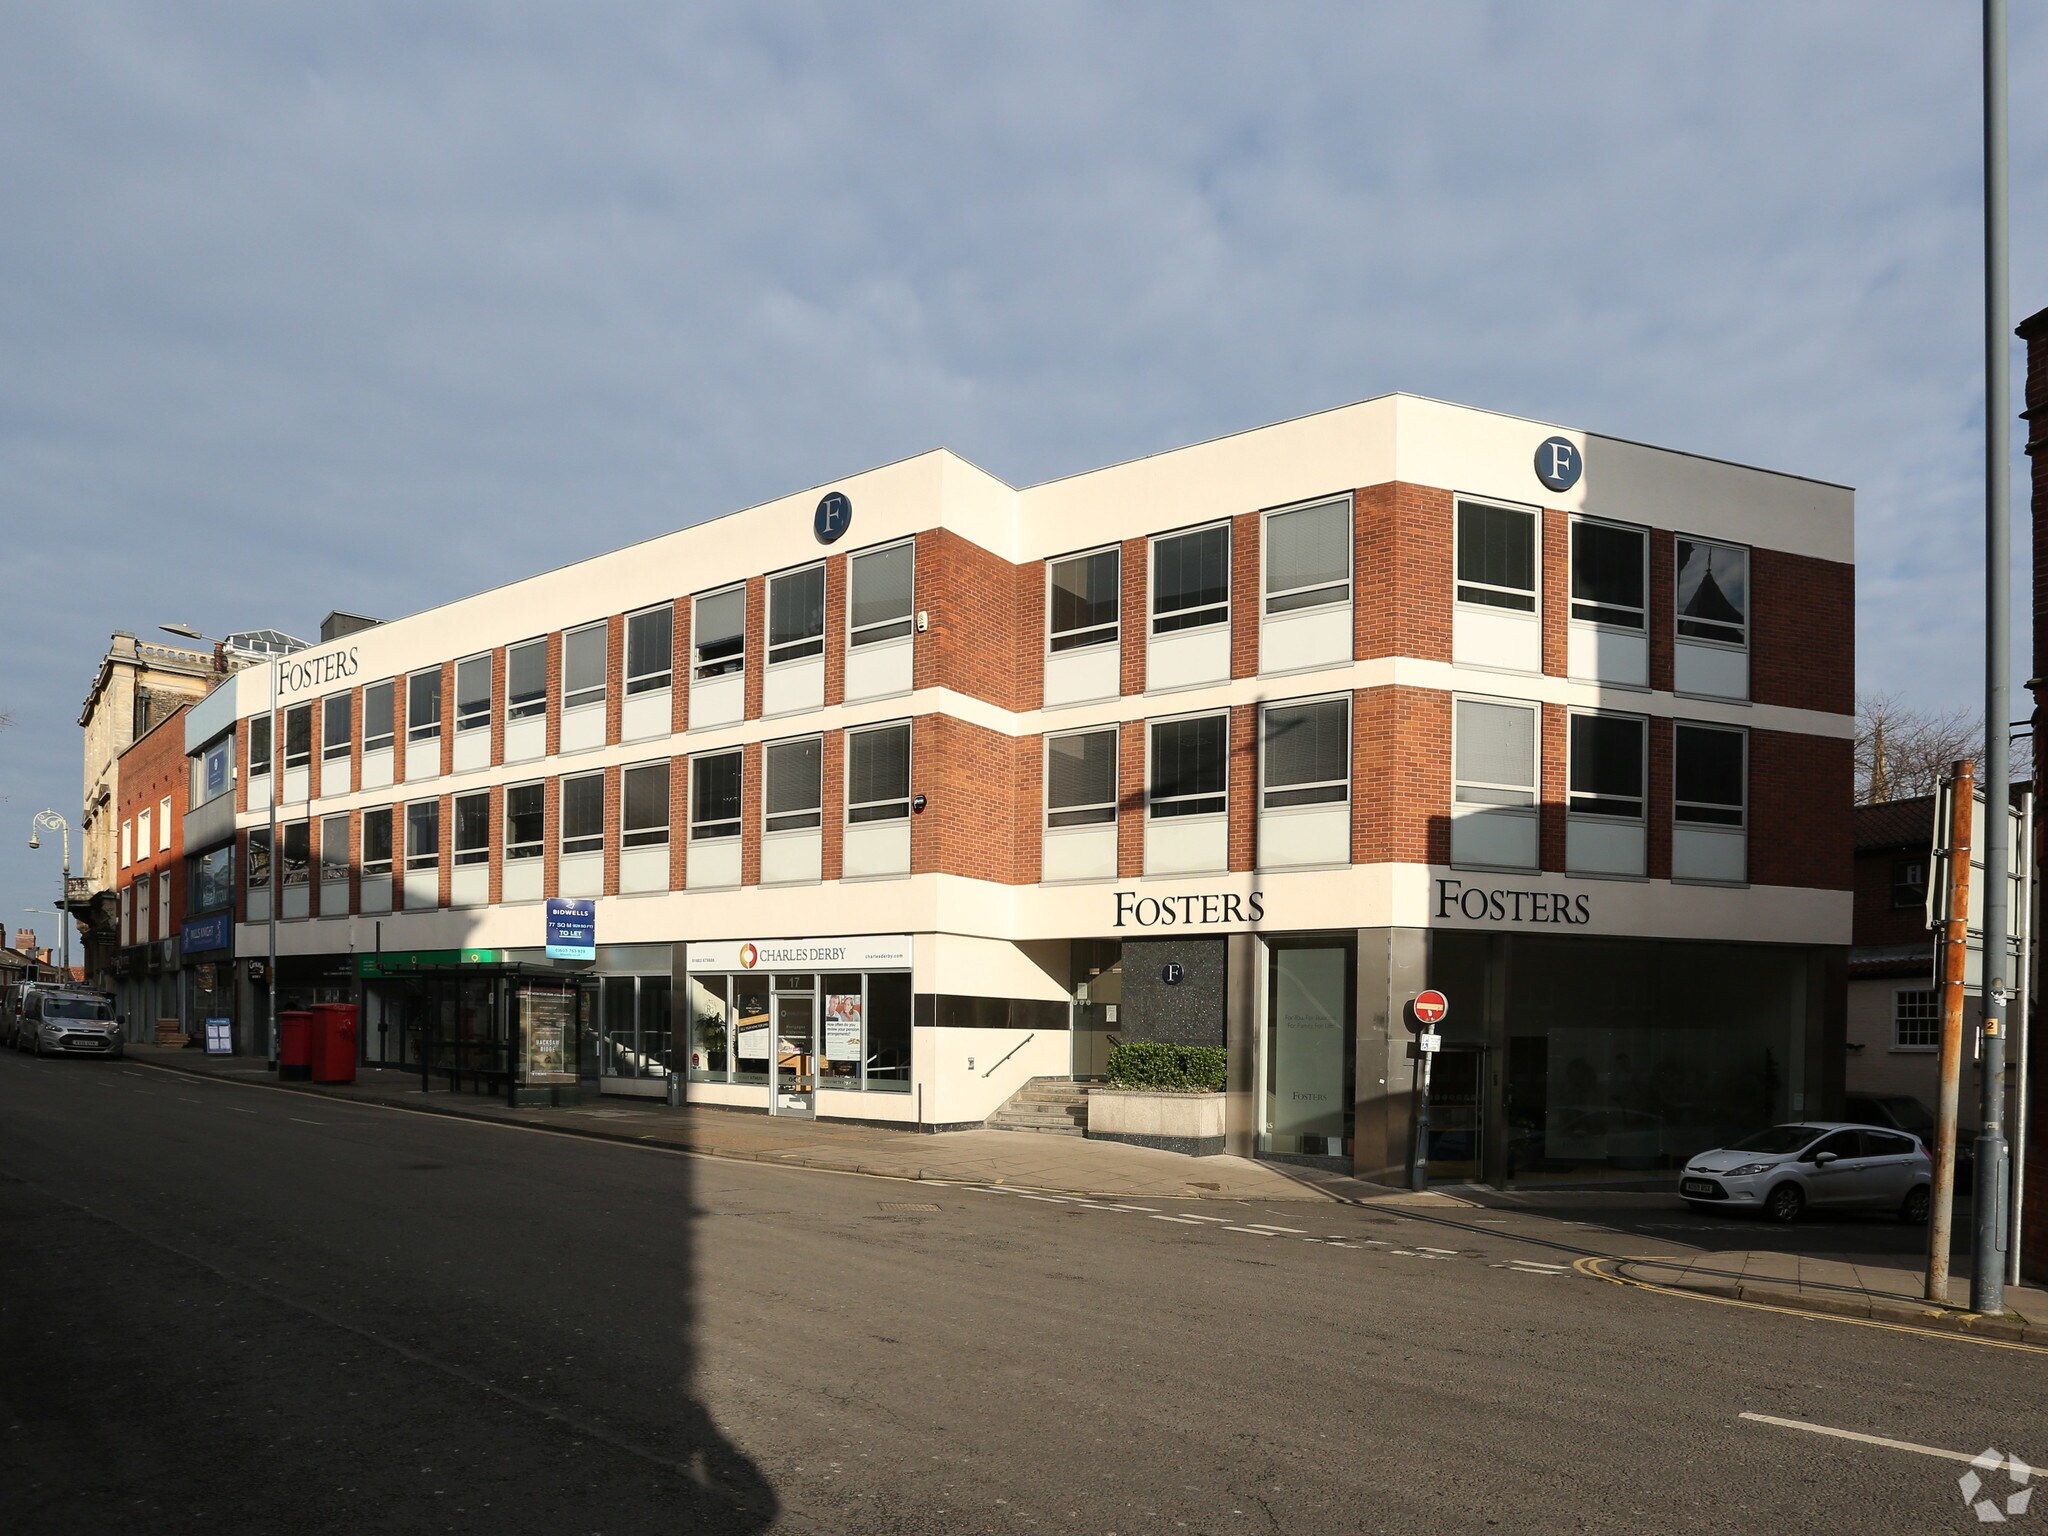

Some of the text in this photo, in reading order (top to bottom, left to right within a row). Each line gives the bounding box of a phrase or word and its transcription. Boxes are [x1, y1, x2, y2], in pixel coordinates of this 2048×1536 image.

[1547, 442, 1572, 481] F
[823, 497, 842, 533] F
[278, 646, 358, 696] FOSTERS
[1113, 891, 1264, 927] FOSTERS
[1435, 879, 1590, 924] FOSTERS
[552, 909, 589, 917] BIDWELLS
[759, 947, 847, 962] CHARLES DERBY
[789, 976, 800, 988] 17
[1167, 964, 1180, 982] F
[1987, 1021, 1994, 1029] 2
[1292, 1091, 1328, 1102] FOSTERS
